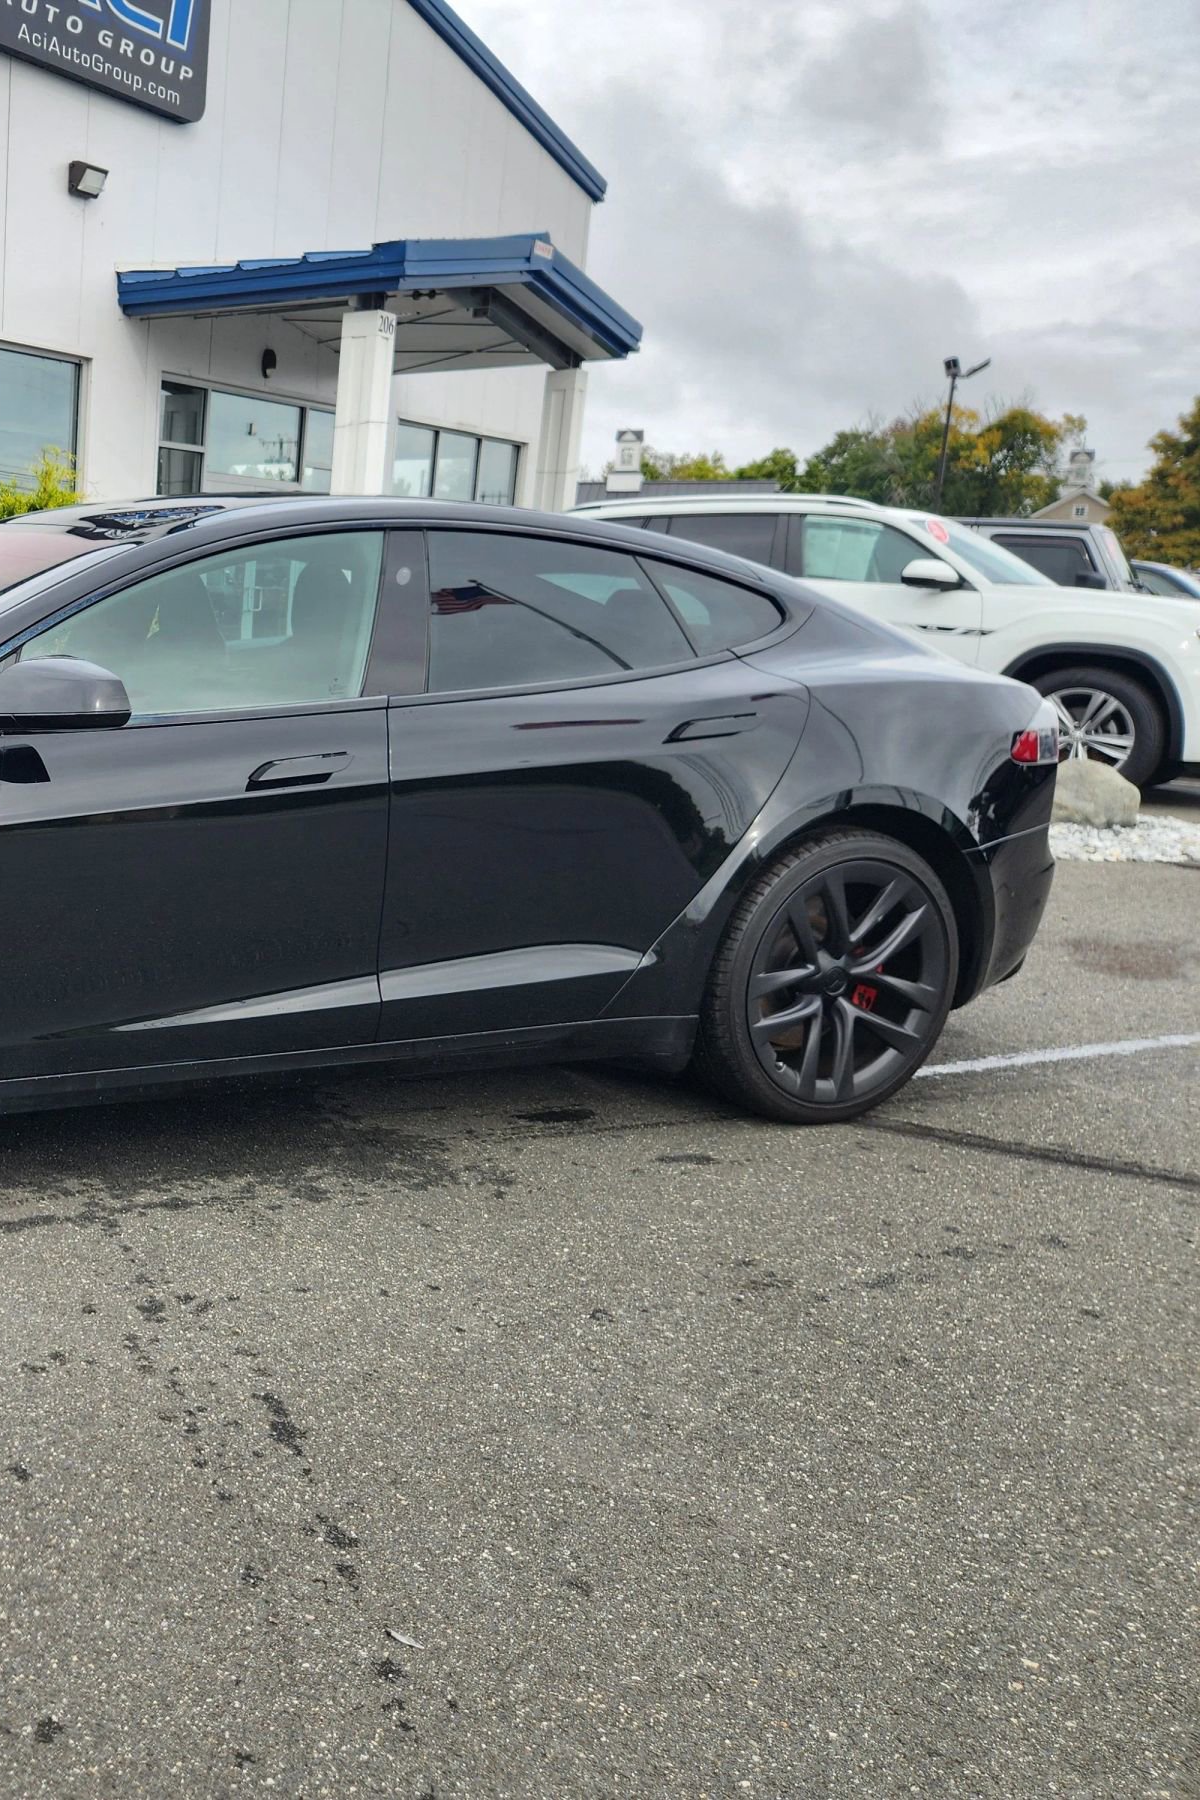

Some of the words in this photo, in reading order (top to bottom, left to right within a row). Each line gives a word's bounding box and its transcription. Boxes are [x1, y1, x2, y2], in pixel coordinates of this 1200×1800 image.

[6, 0, 83, 34] UTO
[97, 29, 193, 80] GROUP
[17, 23, 180, 105] AciAutoGroup.com
[377, 315, 394, 335] 206
